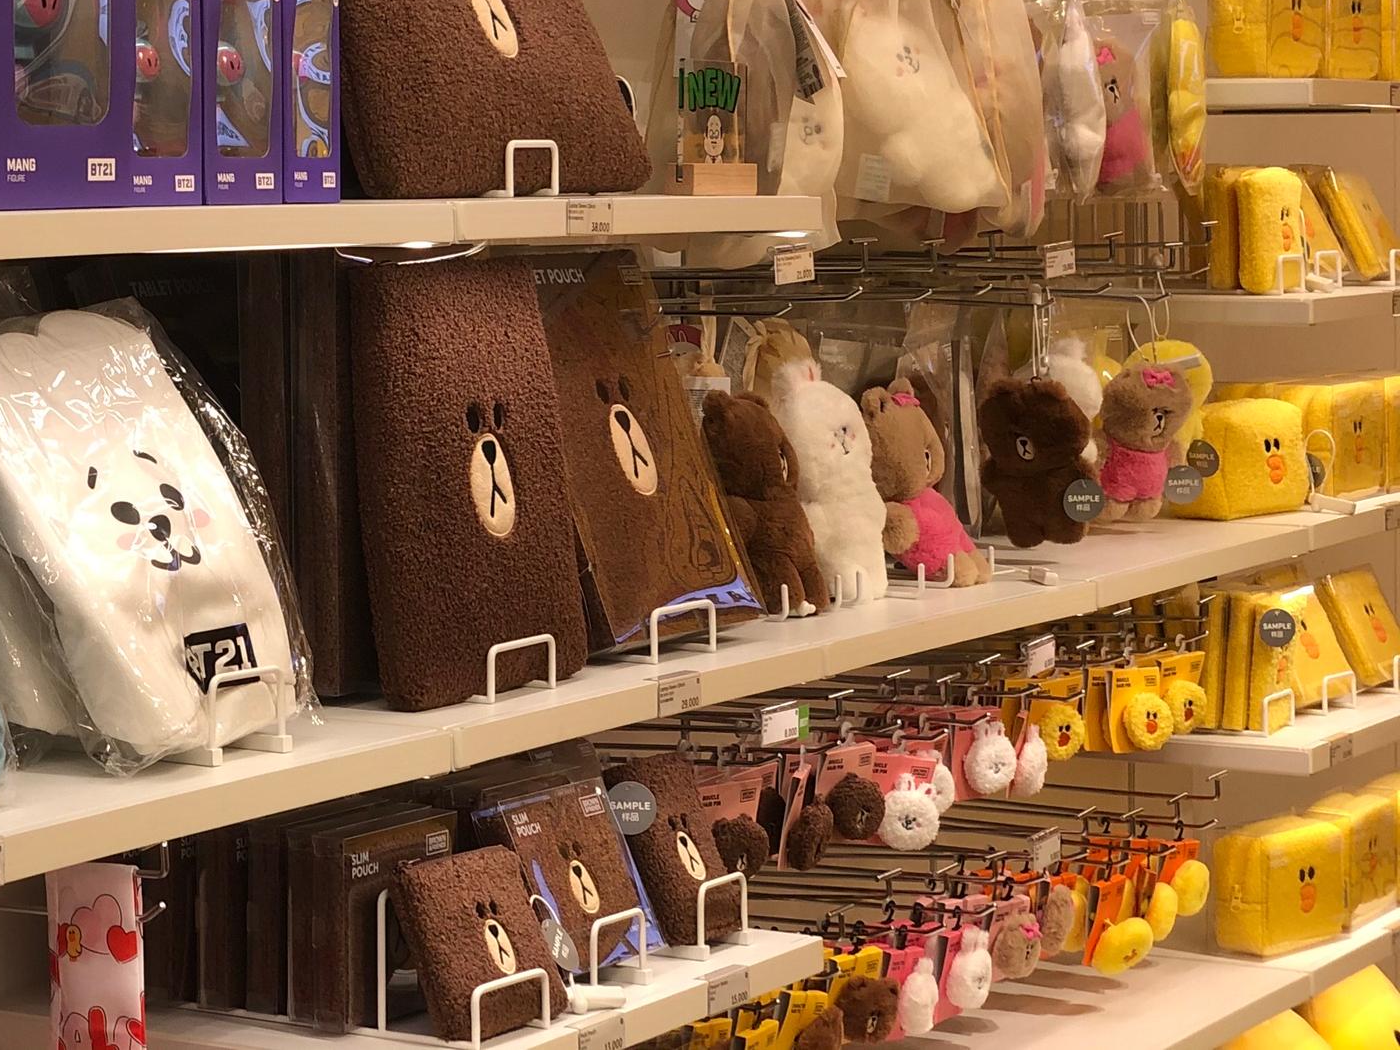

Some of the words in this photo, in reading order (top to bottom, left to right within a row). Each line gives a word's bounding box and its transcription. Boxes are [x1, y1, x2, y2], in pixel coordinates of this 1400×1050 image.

[687, 68, 741, 113] NEW
[7, 158, 36, 172] MANG
[90, 162, 113, 177] BT21
[7, 174, 26, 183] FIGURE
[133, 175, 153, 186] MANG
[217, 173, 235, 183] MANG
[257, 176, 273, 186] BT21
[294, 171, 308, 181] MANG
[323, 175, 335, 185] BT21
[177, 179, 193, 189] BT21
[549, 268, 586, 284] POUCH
[1189, 452, 1215, 461] SAMPLE
[1168, 479, 1199, 487] SAMPLE
[1067, 494, 1100, 502] SAMPLE
[610, 801, 651, 810] SAMPLE
[511, 811, 529, 825] SLIM
[516, 822, 542, 837] POUCH
[351, 851, 369, 866] SLIM
[351, 862, 379, 879] POUCH
